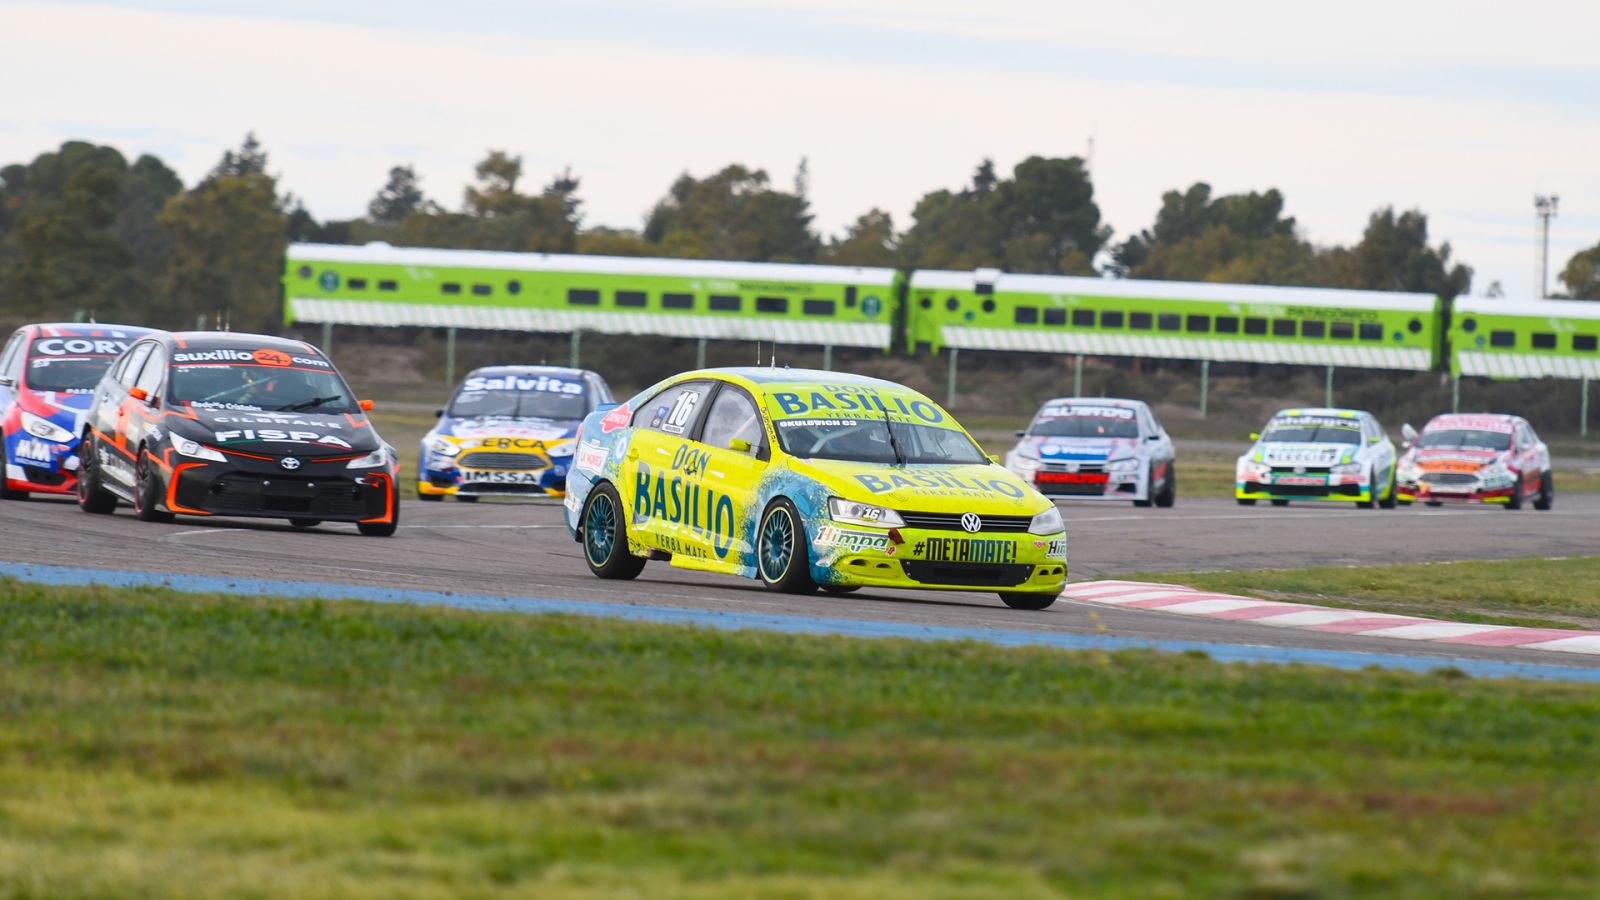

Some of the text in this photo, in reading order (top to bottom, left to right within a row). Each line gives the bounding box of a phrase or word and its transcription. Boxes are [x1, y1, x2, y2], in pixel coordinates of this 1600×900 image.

[463, 376, 583, 394] Salvita
[821, 384, 880, 395] DON
[668, 391, 699, 427] 16
[773, 392, 943, 424] BASILIO
[213, 417, 342, 429] CILBRAKE
[214, 429, 353, 449] FISPA
[671, 443, 712, 481] DON
[465, 471, 537, 483] IMSSA
[853, 474, 1025, 498] BASILIO
[631, 460, 735, 559] BASILIO
[863, 507, 881, 520] 16
[655, 530, 708, 560] YERBA MATE
[912, 537, 1017, 564] #METAMATE!
